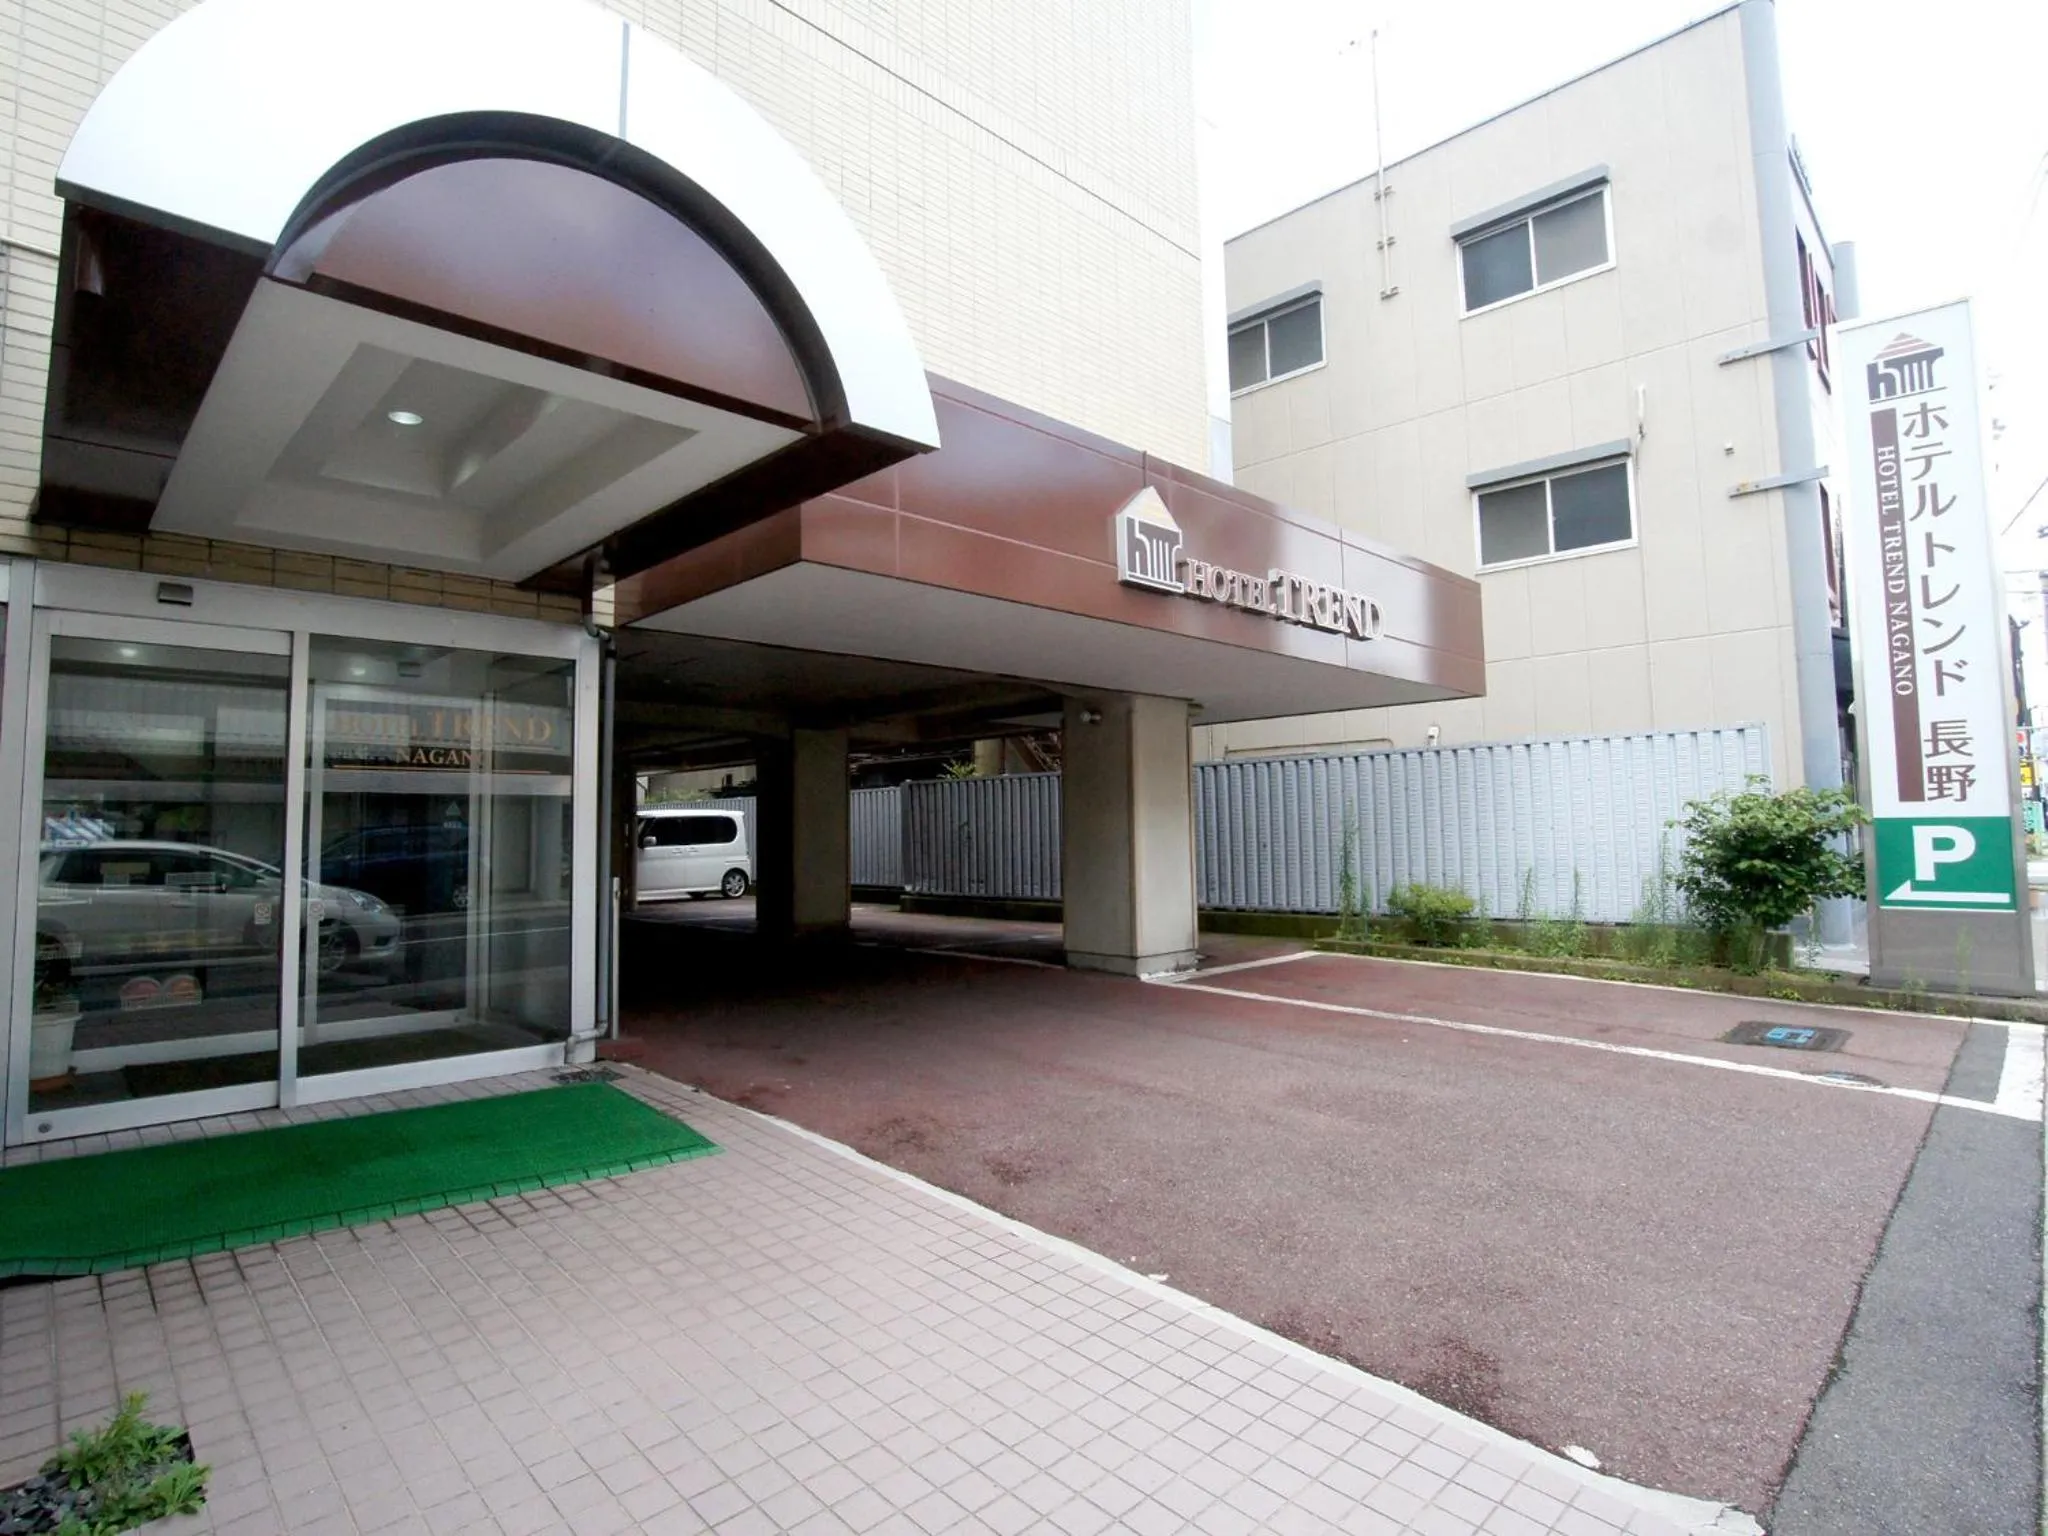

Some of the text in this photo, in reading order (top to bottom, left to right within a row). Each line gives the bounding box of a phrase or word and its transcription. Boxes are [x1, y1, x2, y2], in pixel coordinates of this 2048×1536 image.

[1186, 558, 1386, 639] HOTEL TREND
[1878, 445, 1914, 696] HOTEL TREND NAGANO
[395, 747, 482, 766] NAGAN
[1912, 825, 1977, 881] P
